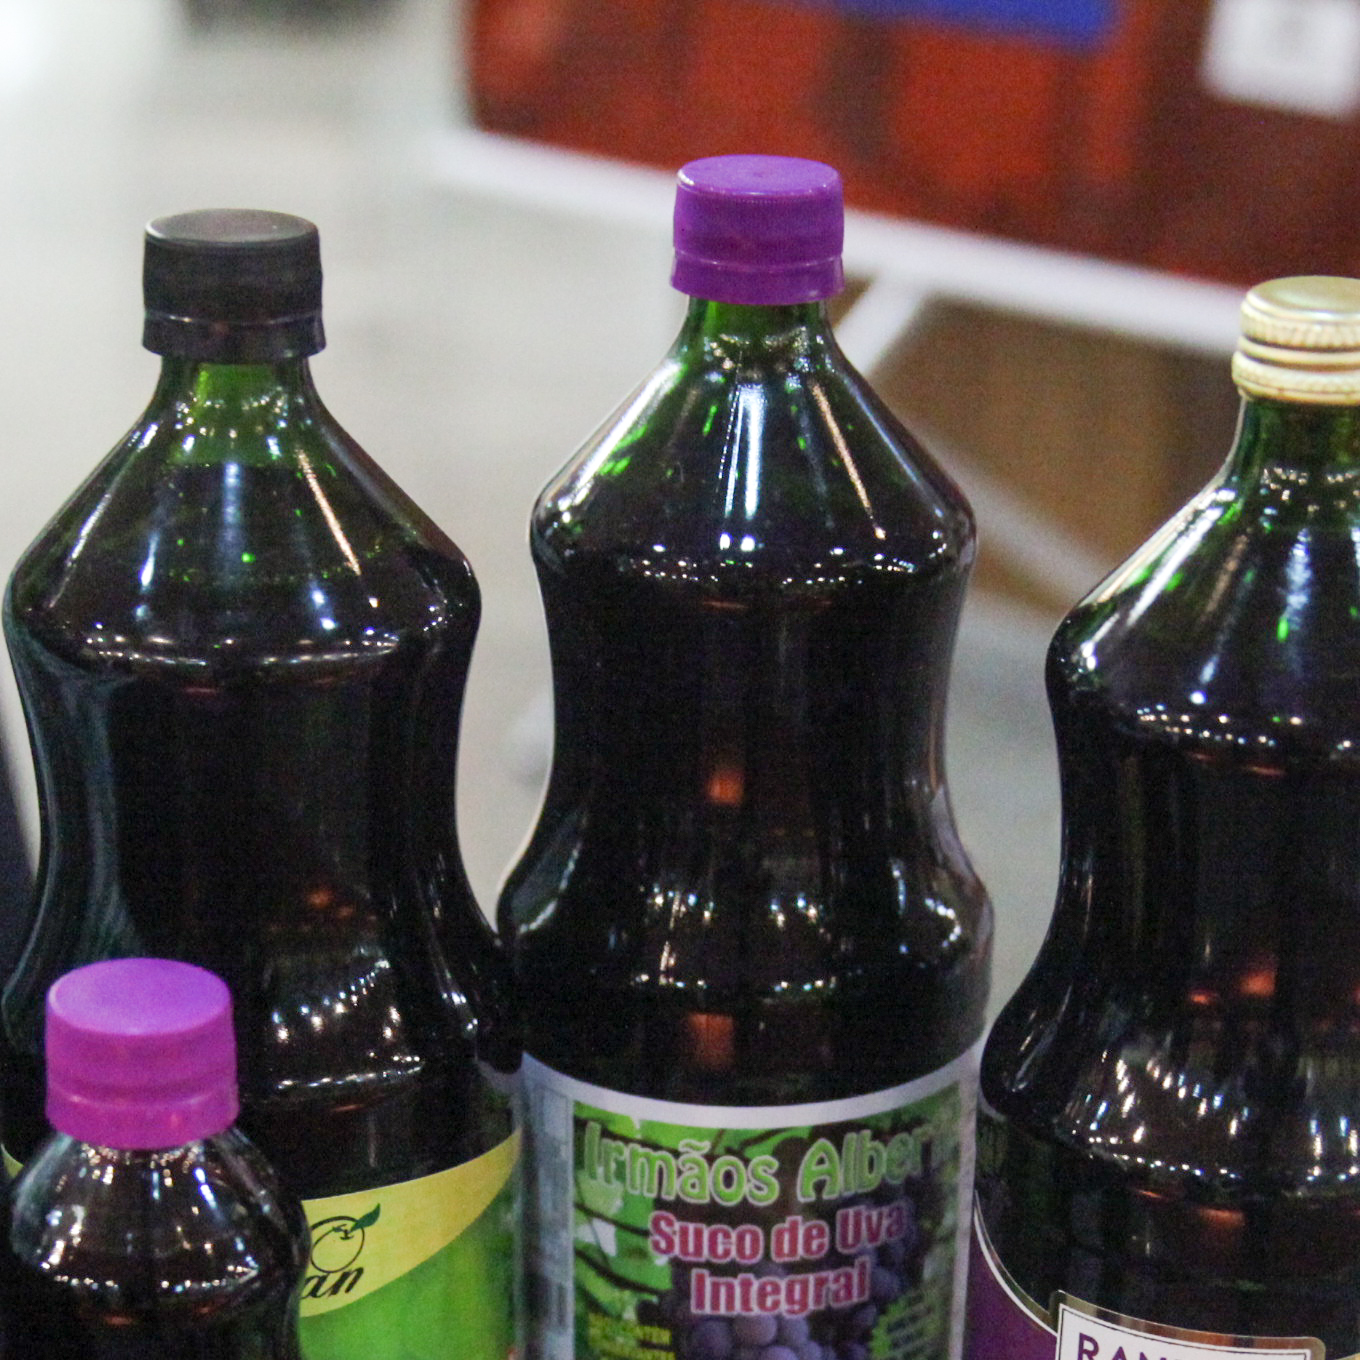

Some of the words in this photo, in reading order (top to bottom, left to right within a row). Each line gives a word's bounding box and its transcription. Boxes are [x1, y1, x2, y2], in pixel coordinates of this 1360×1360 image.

[584, 1121, 780, 1207] Irmãos
[648, 1209, 765, 1265] Suco
[770, 1215, 830, 1263] de
[835, 1201, 908, 1254] Uva
[300, 1266, 365, 1300] an
[690, 1255, 871, 1318] Integral
